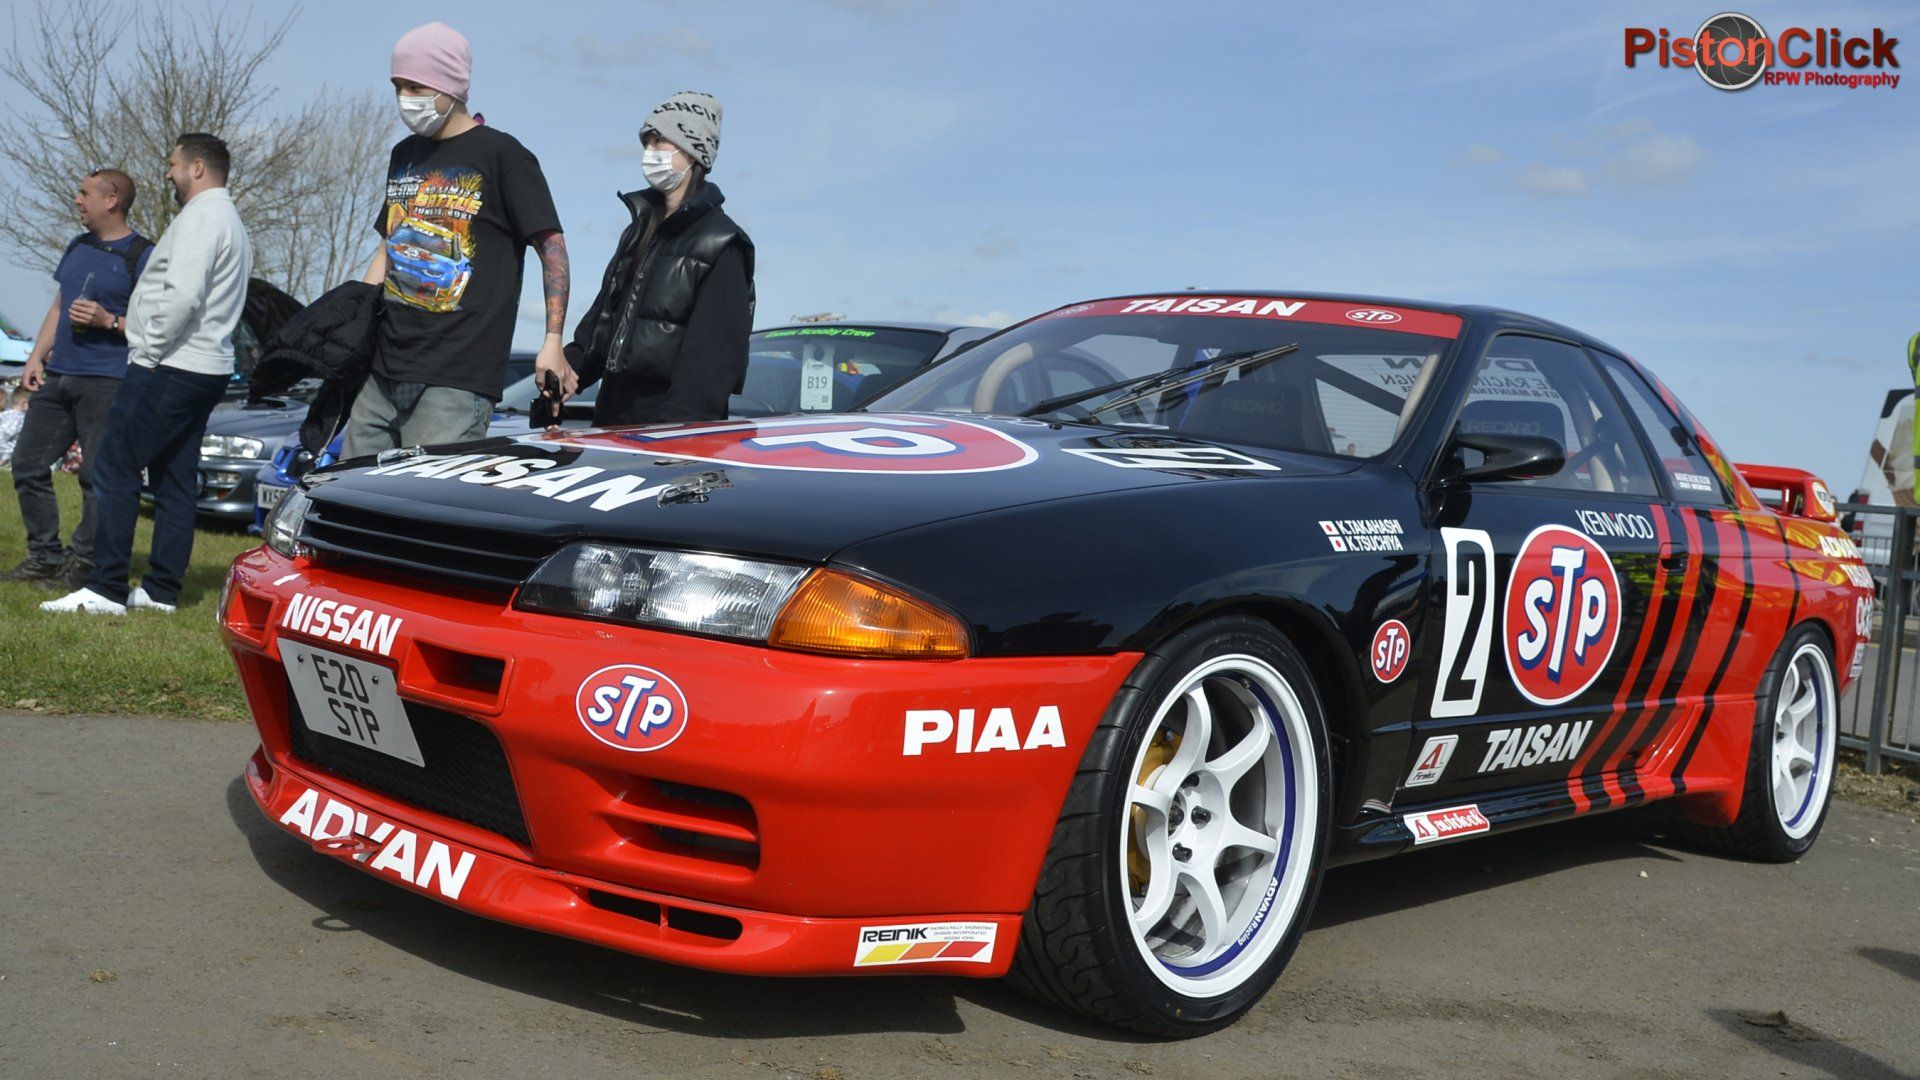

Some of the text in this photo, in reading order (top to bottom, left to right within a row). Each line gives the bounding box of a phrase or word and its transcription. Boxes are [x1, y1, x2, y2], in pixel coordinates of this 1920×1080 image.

[414, 193, 484, 216] BATTLE
[1119, 298, 1307, 316] TAISAN
[1351, 310, 1396, 322] STP
[842, 328, 876, 337] Crew
[807, 376, 828, 389] B19
[364, 453, 671, 512] TAISAN
[1335, 519, 1404, 535] K.TAKAHASHI
[1345, 535, 1404, 551] K.TSUCHIYA
[1575, 509, 1654, 539] KENWOOD
[282, 592, 403, 656] NISSAN
[1441, 540, 1487, 702] 2
[1517, 546, 1608, 684] STP
[1375, 628, 1405, 672] STP
[311, 653, 369, 704] E20
[328, 697, 380, 745] STP
[587, 674, 673, 740] STP
[902, 705, 1067, 756] PIAA
[1477, 720, 1593, 773] TAISAN
[279, 787, 476, 900] ADVAN
[862, 927, 929, 942] REINIK
[1237, 876, 1279, 946] ADVAN Racing
